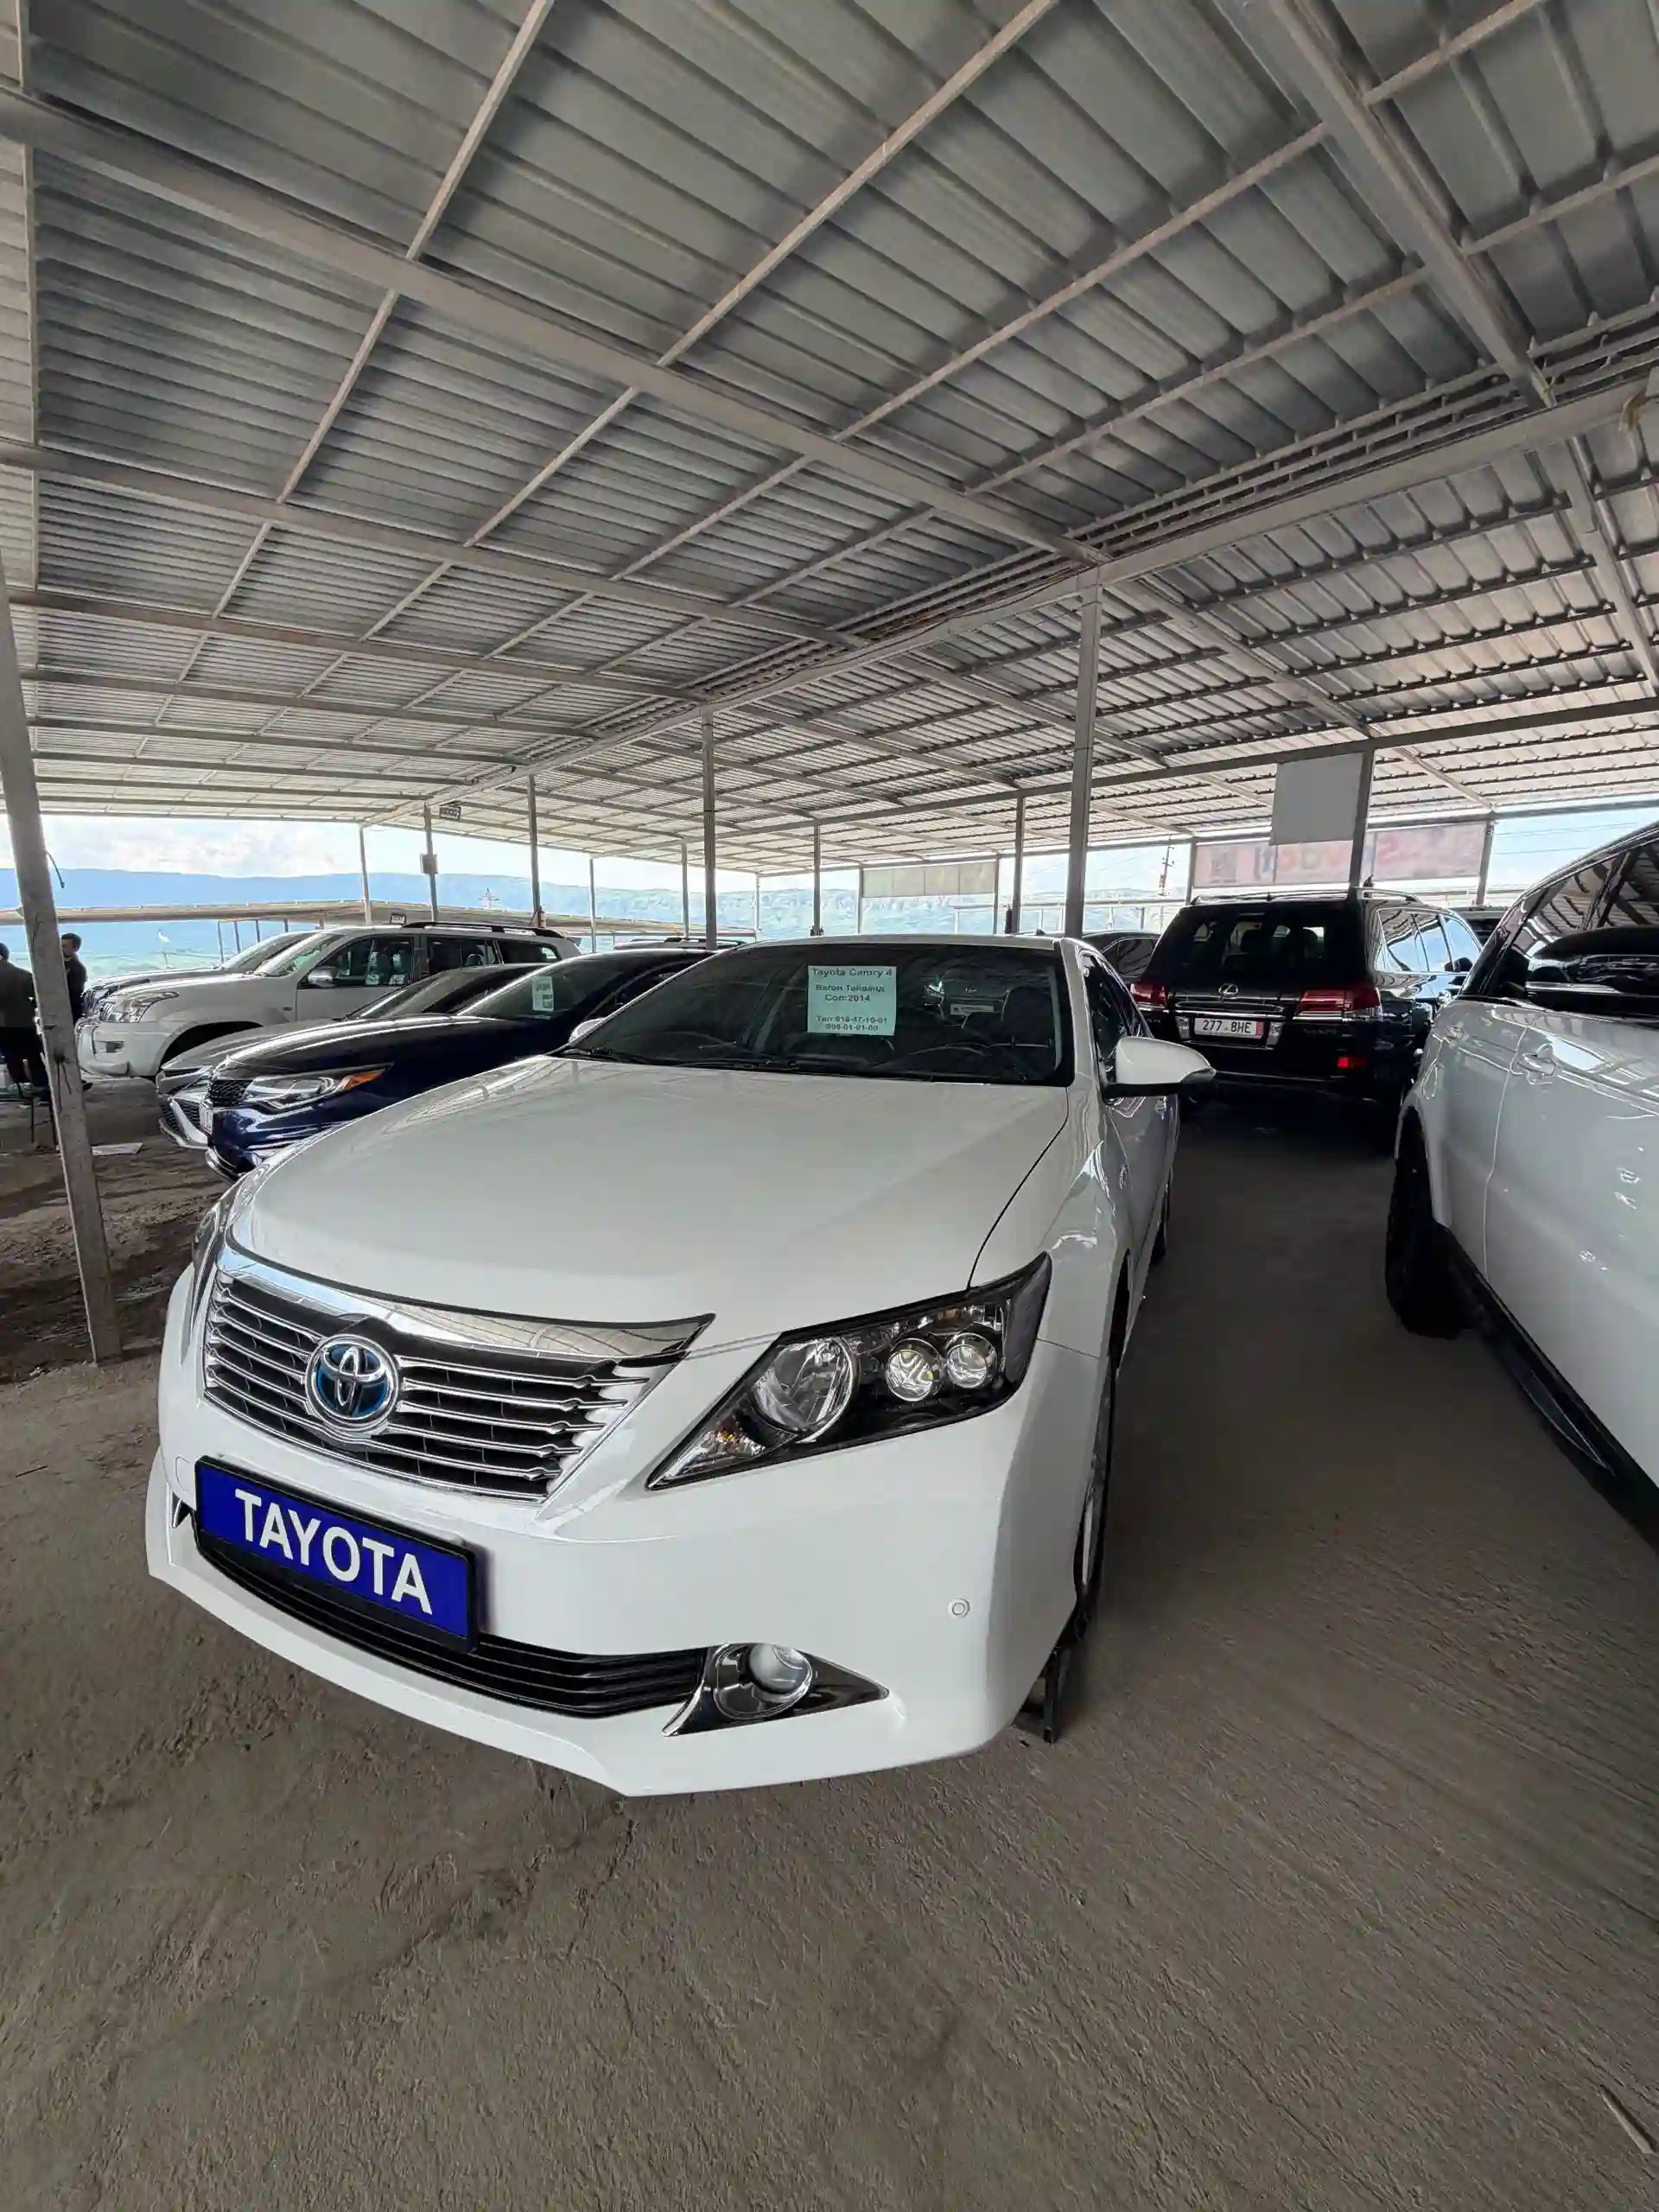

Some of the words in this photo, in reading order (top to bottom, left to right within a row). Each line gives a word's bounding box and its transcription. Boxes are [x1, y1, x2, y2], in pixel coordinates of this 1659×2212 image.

[849, 968, 883, 978] Camry
[1203, 1020, 1223, 1032] 277
[235, 1488, 433, 1616] TAYOTA
